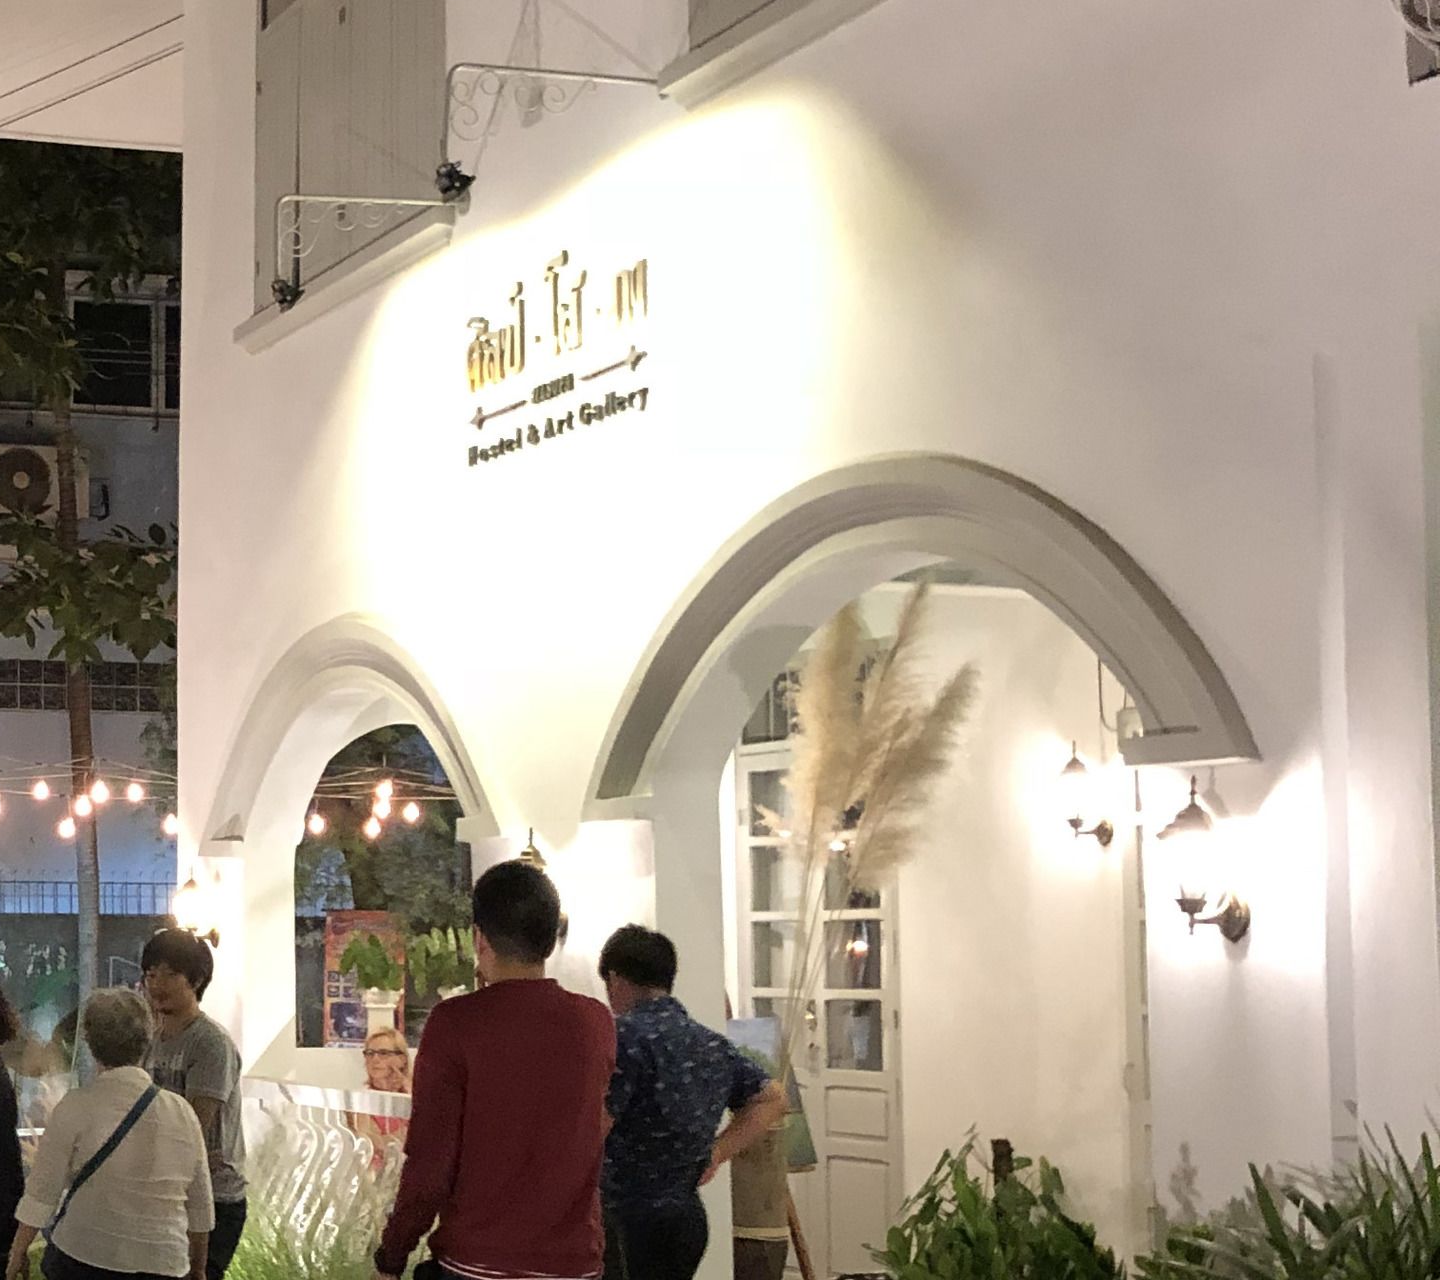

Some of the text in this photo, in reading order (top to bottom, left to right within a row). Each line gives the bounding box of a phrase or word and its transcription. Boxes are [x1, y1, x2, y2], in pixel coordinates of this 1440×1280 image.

[468, 428, 522, 466] Hostel
[527, 424, 540, 445] &
[544, 411, 574, 438] Art
[579, 387, 649, 425] Gallery
